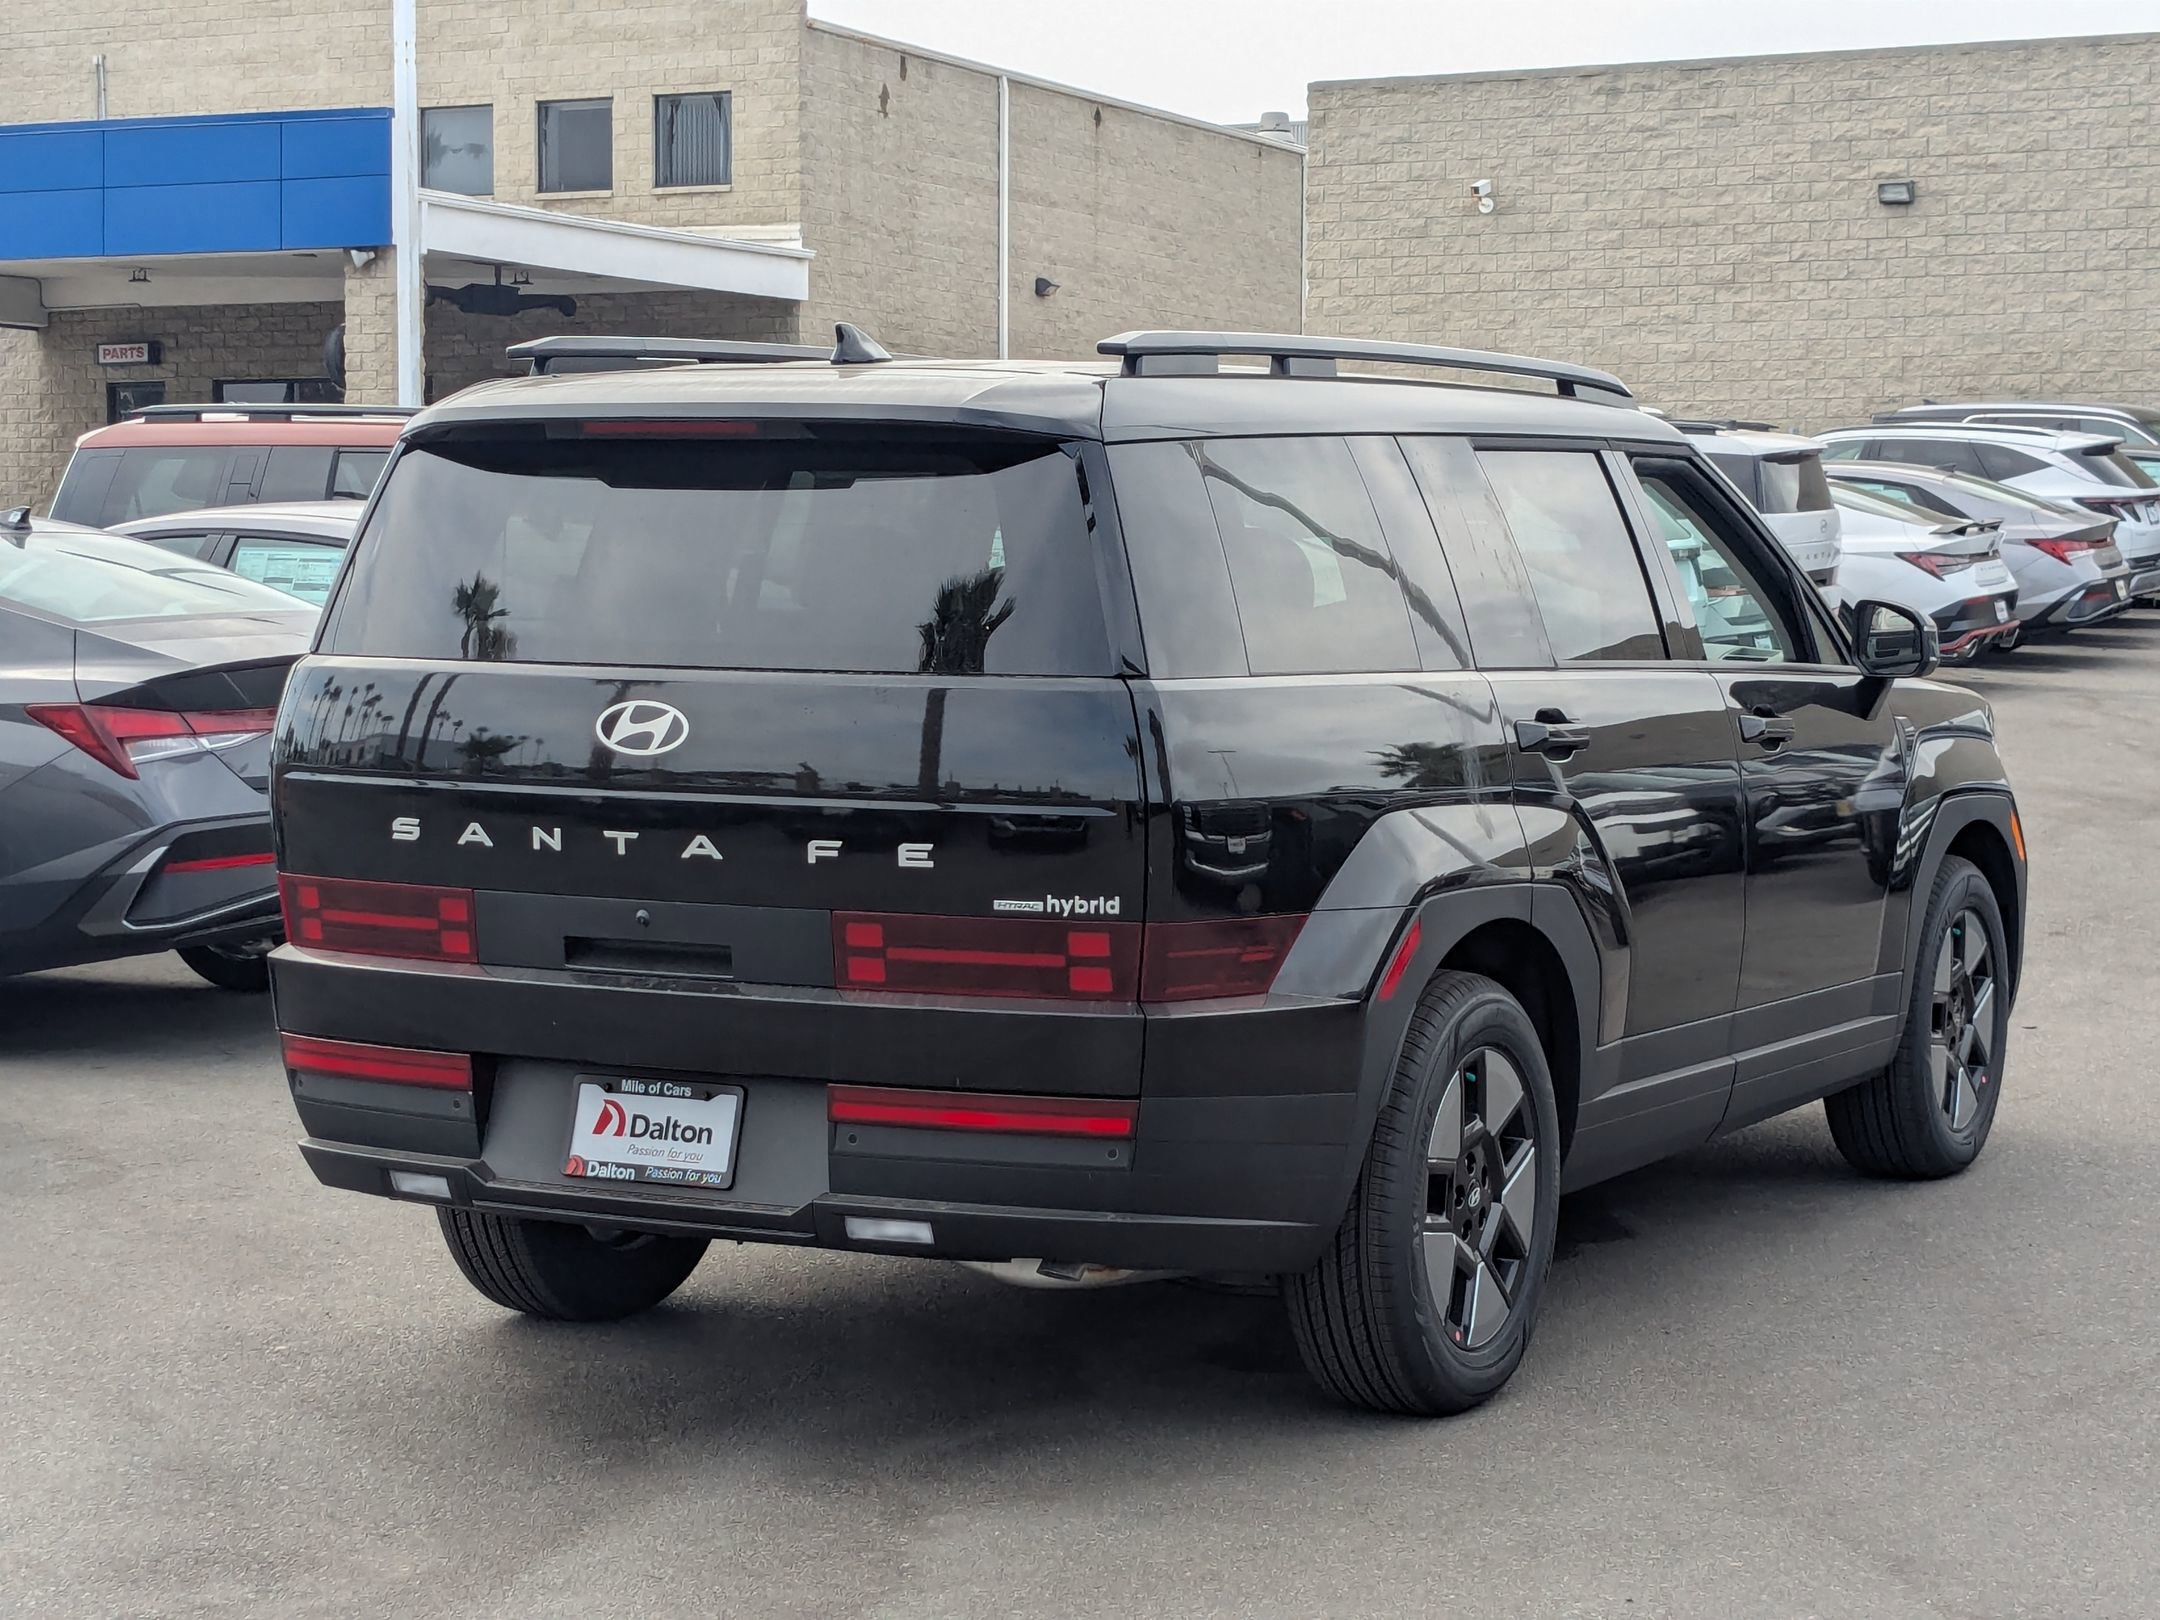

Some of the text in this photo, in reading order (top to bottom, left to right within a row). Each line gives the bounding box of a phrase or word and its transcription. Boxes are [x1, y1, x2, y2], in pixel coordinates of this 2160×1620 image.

[103, 346, 145, 359] PARTS
[391, 816, 935, 868] SANTA FE
[1046, 894, 1120, 917] hybrid
[621, 1079, 692, 1097] Mile of Cars
[629, 1113, 713, 1145] Dalton
[627, 1144, 704, 1161] Passion for you
[587, 1161, 722, 1184] Dalton Passion for you
